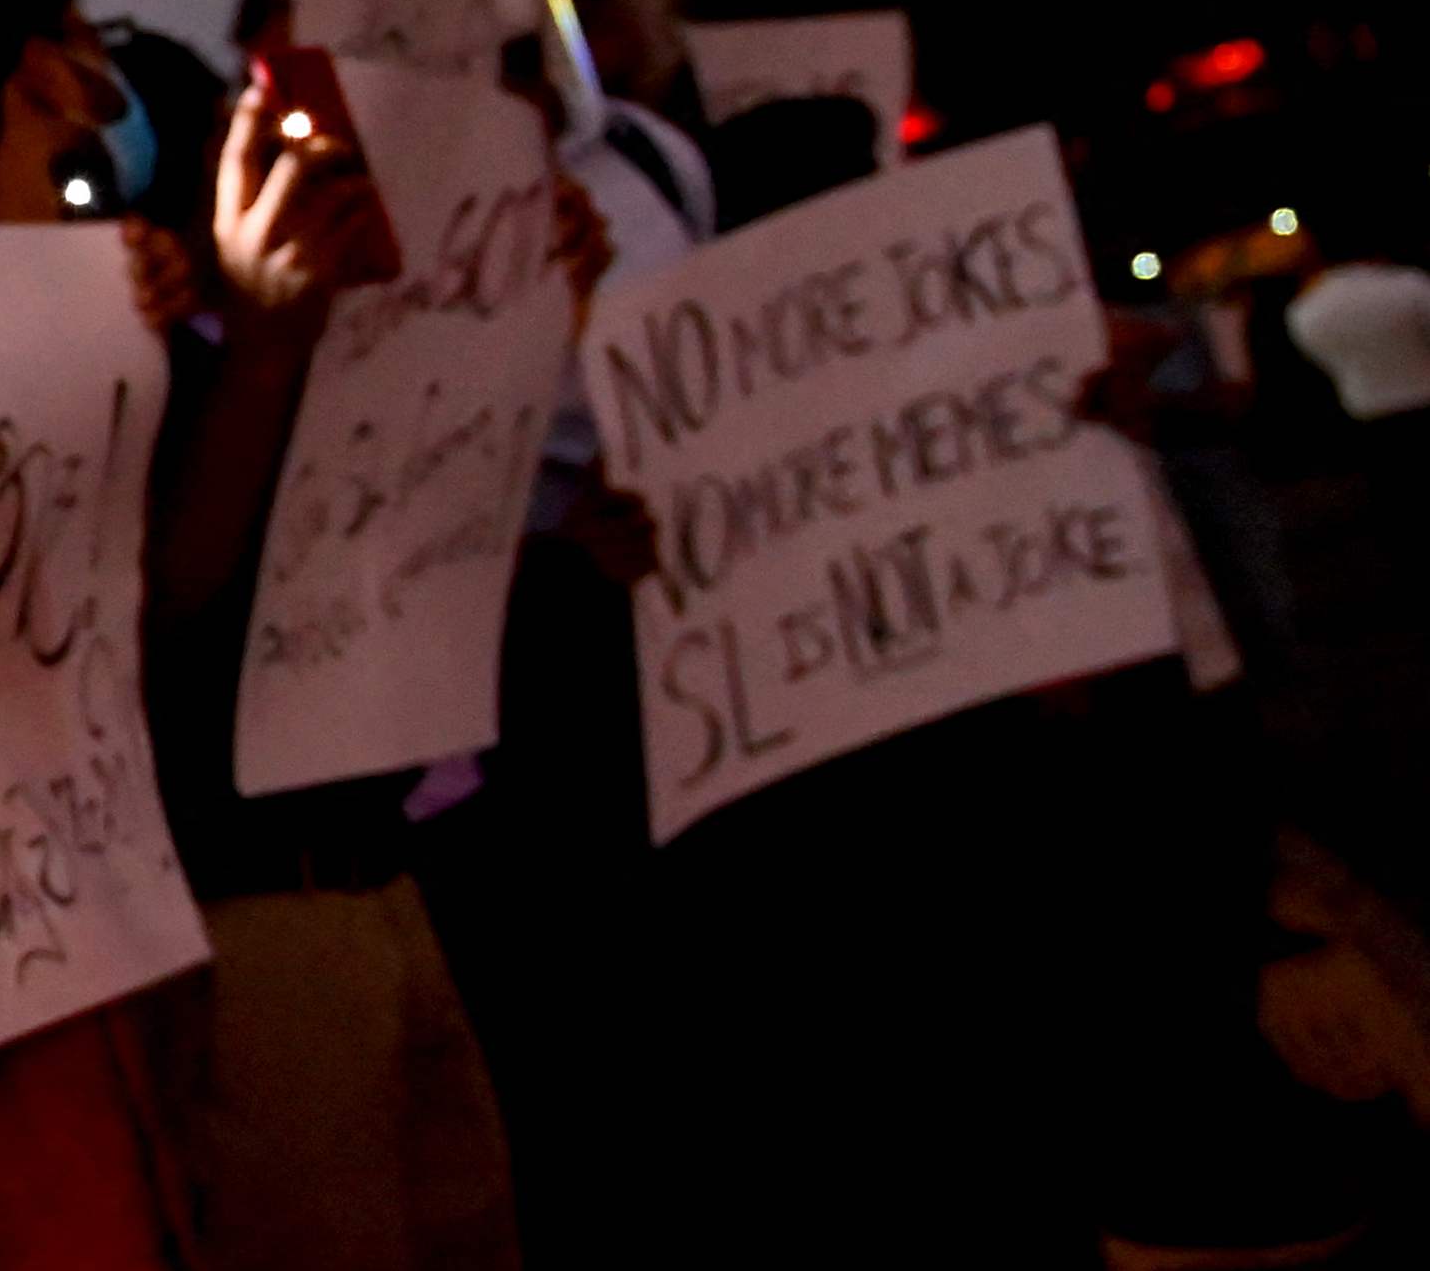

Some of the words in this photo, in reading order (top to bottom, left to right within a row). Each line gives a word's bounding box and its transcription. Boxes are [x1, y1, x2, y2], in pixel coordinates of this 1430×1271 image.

[604, 298, 720, 473] NO
[730, 262, 867, 398] MORE
[886, 200, 1075, 343] JOKES
[875, 355, 1082, 499] MEMES
[660, 623, 794, 789] SL
[983, 502, 1129, 613] JOKE
